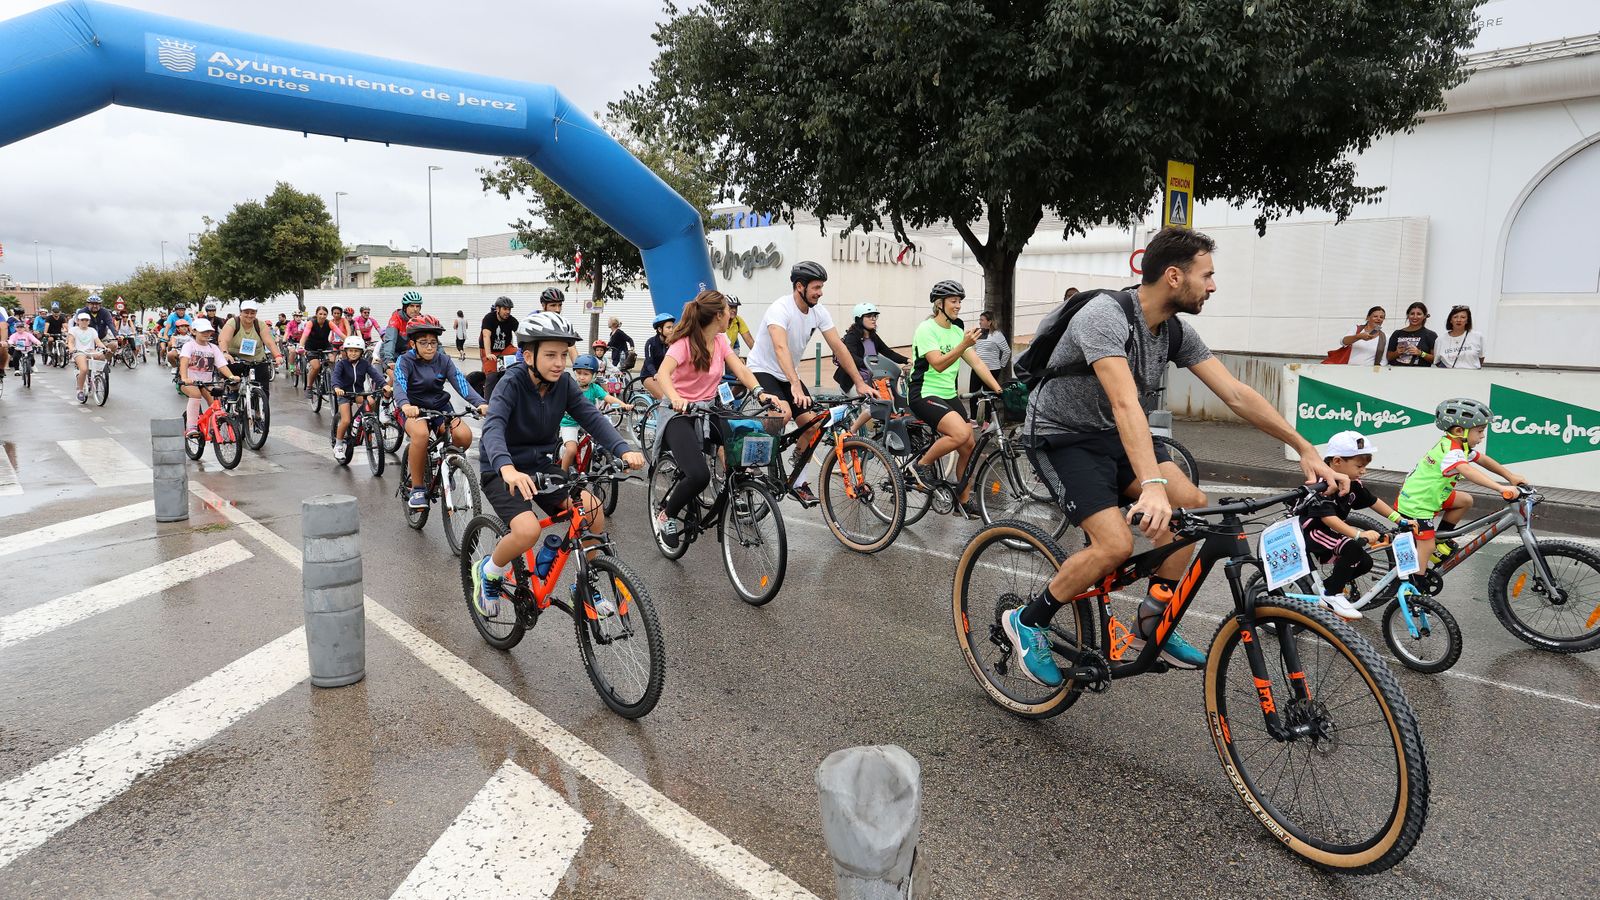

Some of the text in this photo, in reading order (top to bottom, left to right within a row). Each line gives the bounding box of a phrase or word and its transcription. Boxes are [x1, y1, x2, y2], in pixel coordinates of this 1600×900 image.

[207, 66, 310, 92] Deportes
[208, 51, 517, 111] Ayuntamiento de Jerez
[831, 232, 926, 267] HIPERCOR
[1299, 401, 1412, 429] El Corte Inglés
[1490, 415, 1511, 434] El
[1511, 416, 1561, 436] Corte
[1226, 763, 1285, 838] vittoria BARZO
